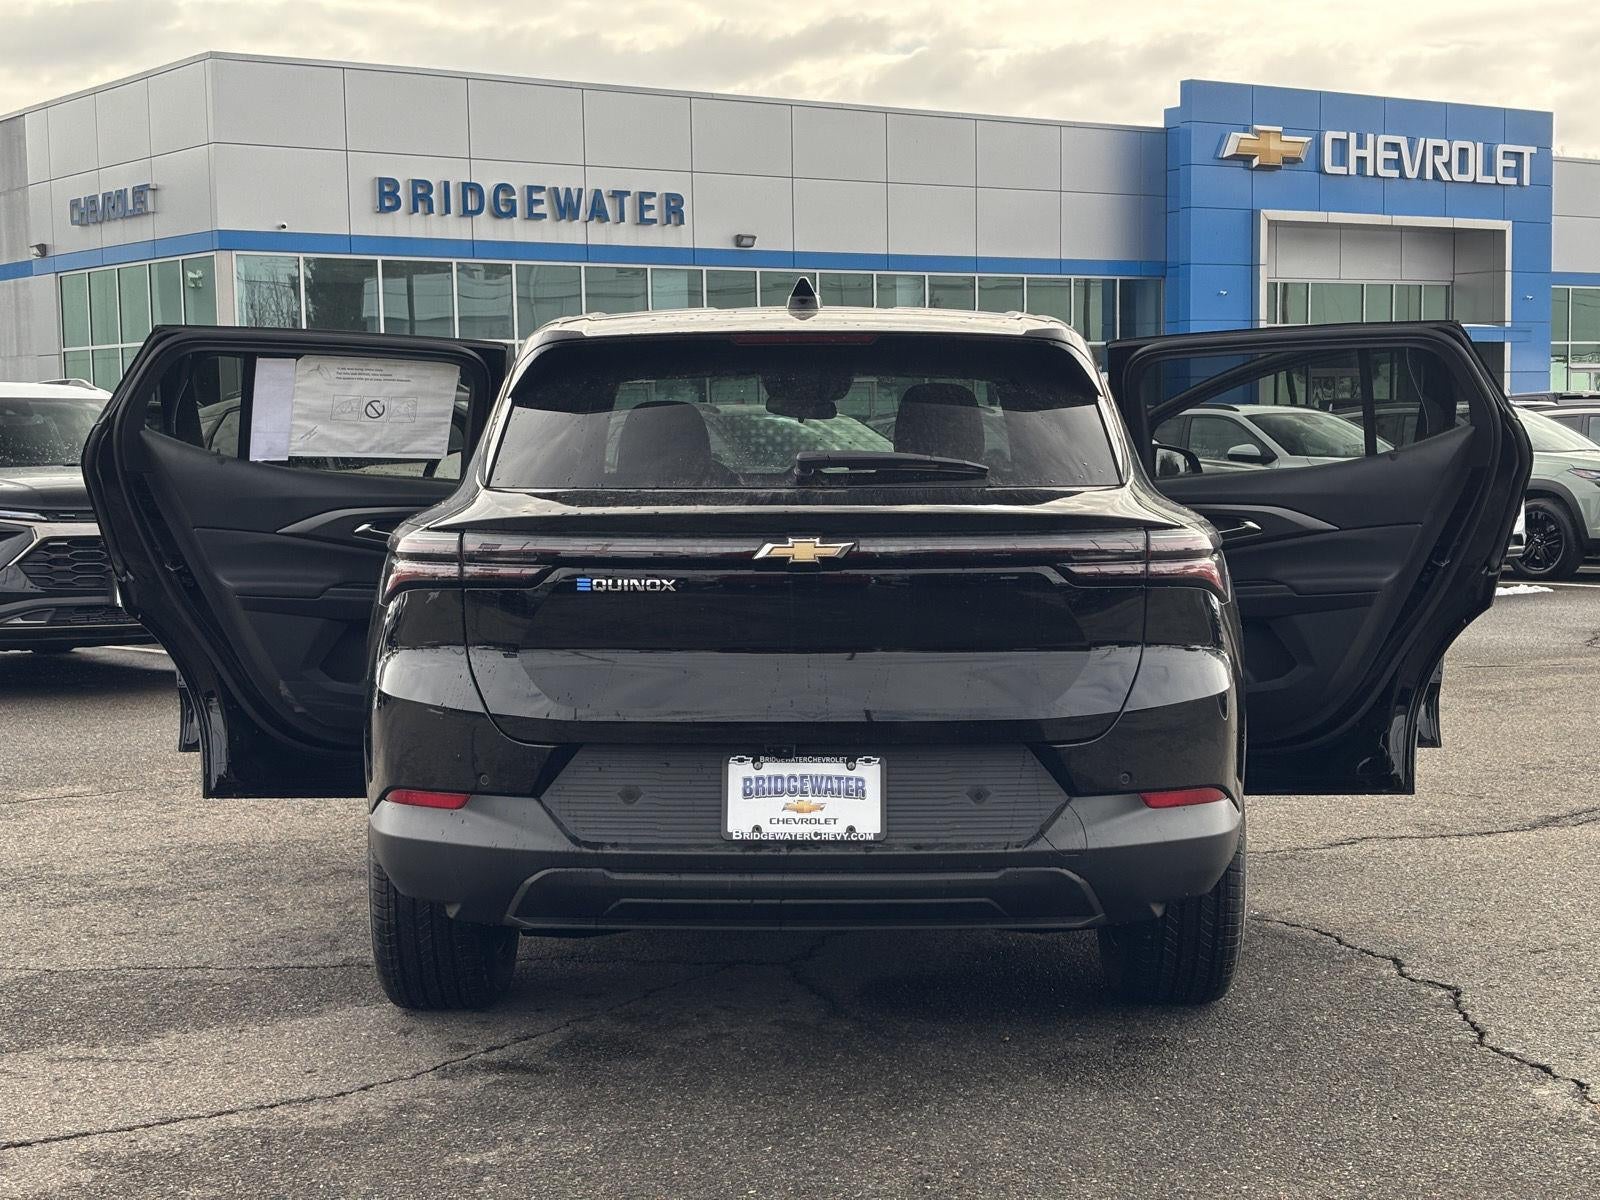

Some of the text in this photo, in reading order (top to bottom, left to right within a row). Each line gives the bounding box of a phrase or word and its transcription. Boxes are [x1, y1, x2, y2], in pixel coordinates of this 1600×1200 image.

[1324, 131, 1537, 186] CHEVROLET
[70, 183, 157, 226] CHEVROLET
[375, 176, 686, 226] BRIDGEWATER
[577, 578, 676, 592] EQUINOX
[742, 774, 867, 800] BRIDGEWATER
[769, 817, 839, 825] CHEVROLET
